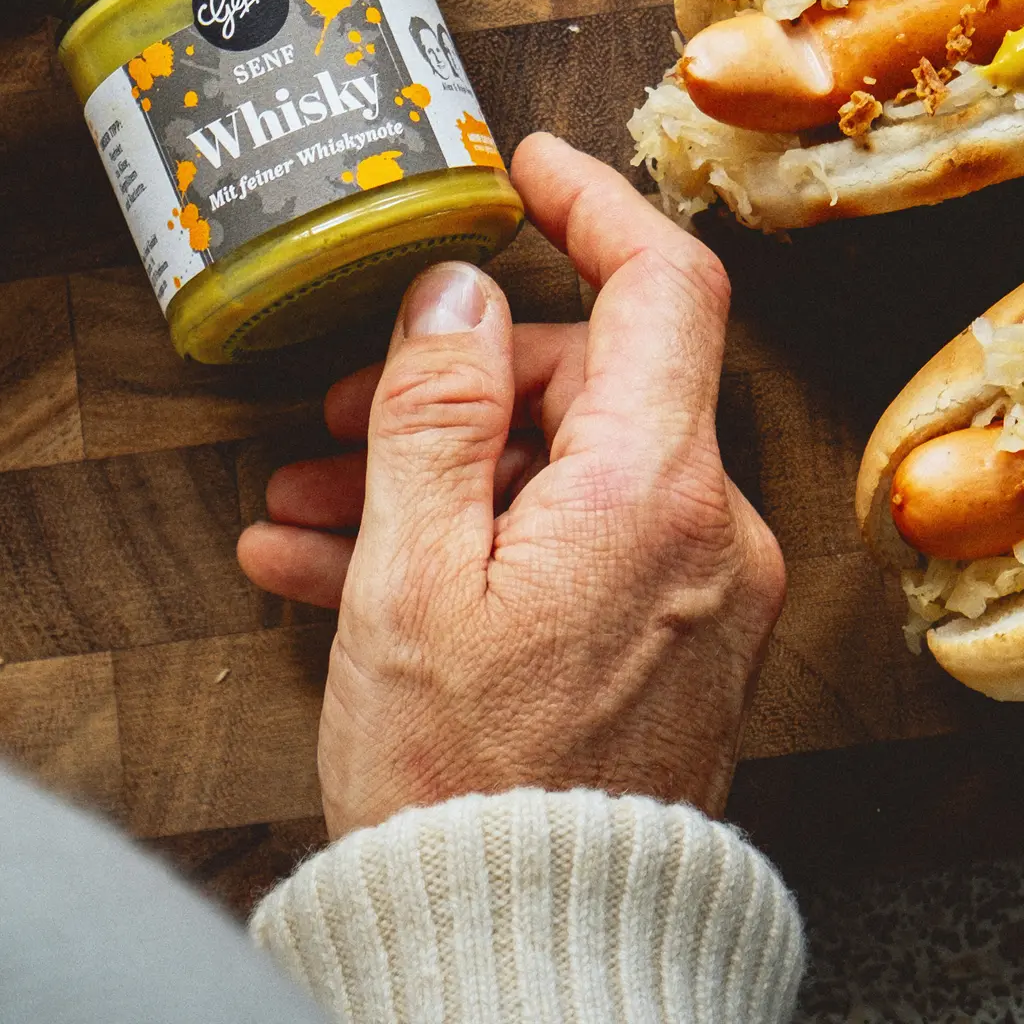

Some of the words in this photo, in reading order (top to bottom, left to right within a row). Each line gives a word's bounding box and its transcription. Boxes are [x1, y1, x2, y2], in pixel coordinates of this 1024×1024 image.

[232, 43, 295, 85] SENF
[187, 71, 380, 168] Whisky
[208, 185, 241, 212] Mit
[237, 159, 294, 200] feiner
[296, 121, 404, 168] Whiskynote
